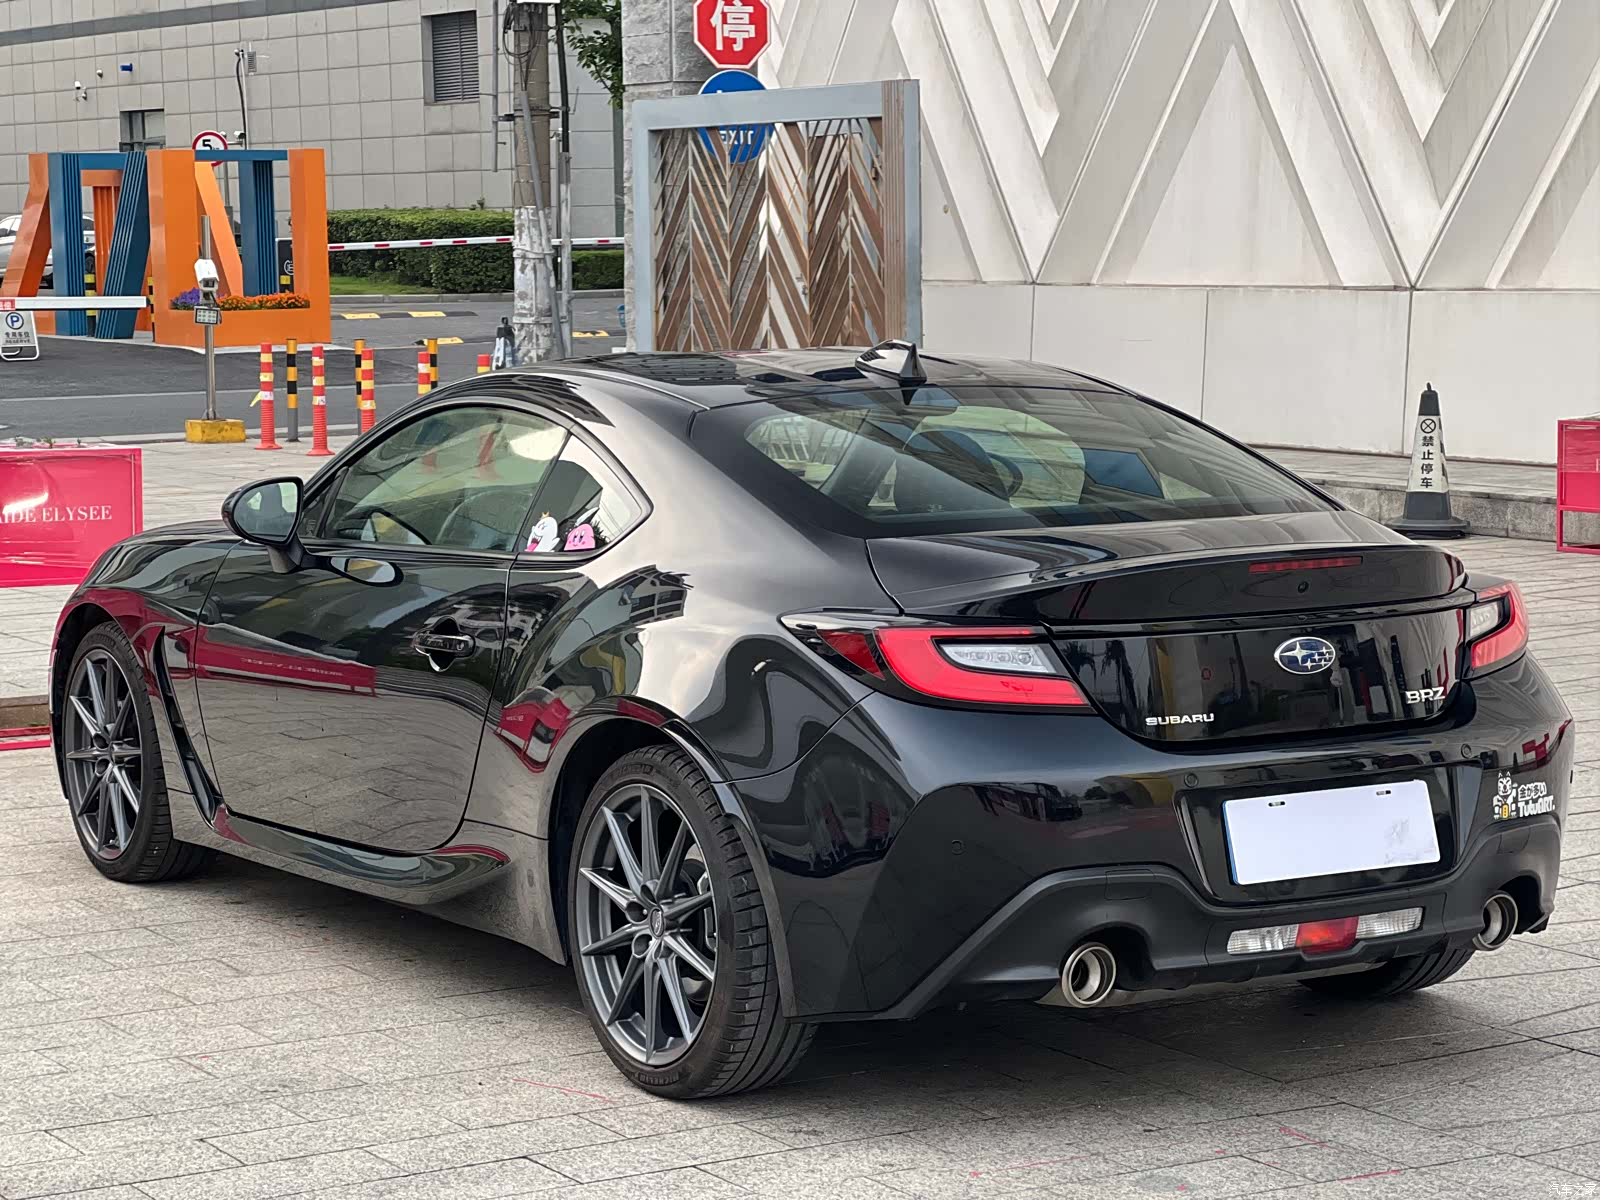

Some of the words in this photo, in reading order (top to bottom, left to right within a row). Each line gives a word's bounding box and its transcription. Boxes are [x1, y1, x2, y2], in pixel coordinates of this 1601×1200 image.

[709, 0, 756, 52] 停
[718, 130, 754, 145] EXIT
[10, 315, 20, 327] P
[1420, 435, 1435, 489] 禁止停车
[0, 507, 36, 524] IDE
[42, 505, 112, 522] ELYSEE
[1405, 686, 1446, 704] BRZ
[1145, 713, 1215, 726] SUBARU
